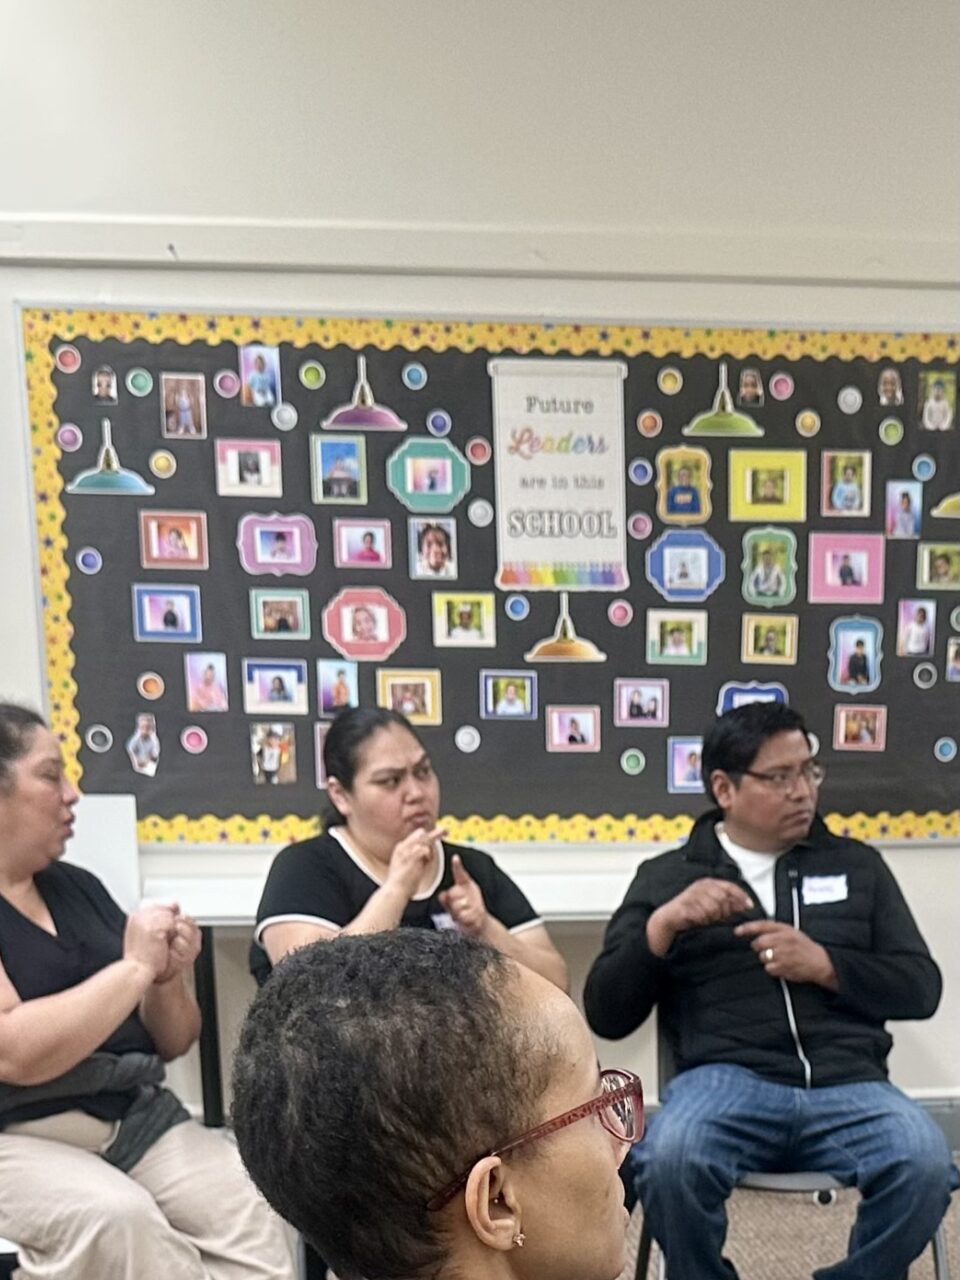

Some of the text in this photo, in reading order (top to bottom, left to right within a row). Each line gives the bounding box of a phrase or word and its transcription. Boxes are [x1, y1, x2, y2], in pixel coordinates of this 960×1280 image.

[526, 396, 594, 414] Future
[508, 427, 609, 460] Leaders
[520, 476, 604, 489] are in this
[507, 510, 618, 538] SCHOOL
